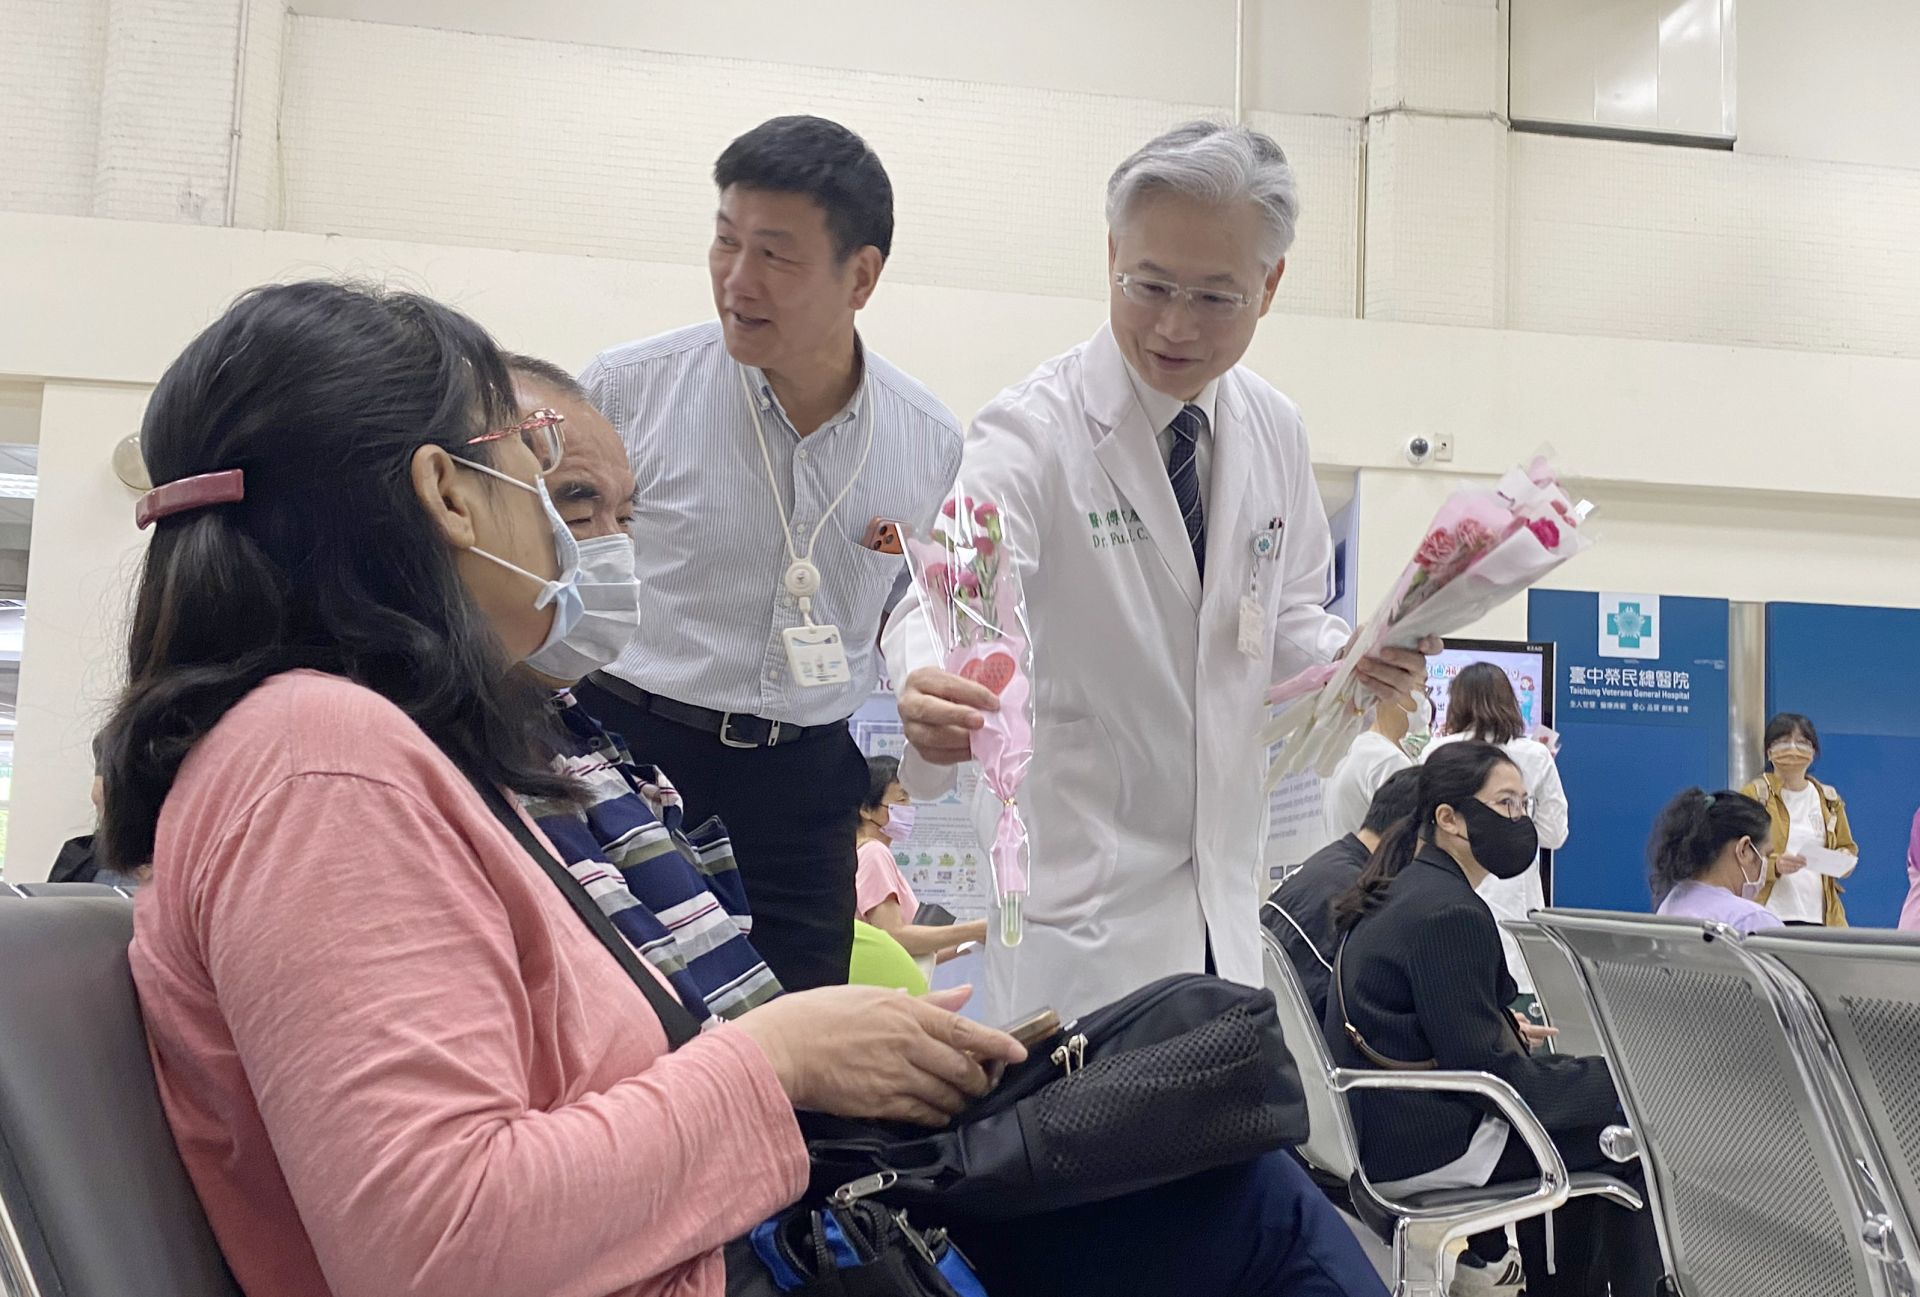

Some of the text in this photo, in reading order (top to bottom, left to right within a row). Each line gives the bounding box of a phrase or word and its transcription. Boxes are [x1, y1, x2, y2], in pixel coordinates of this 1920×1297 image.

[1569, 666, 1690, 689] 臺中榮民總醫院
[1569, 687, 1690, 701] Taichung Veterans General Hospital
